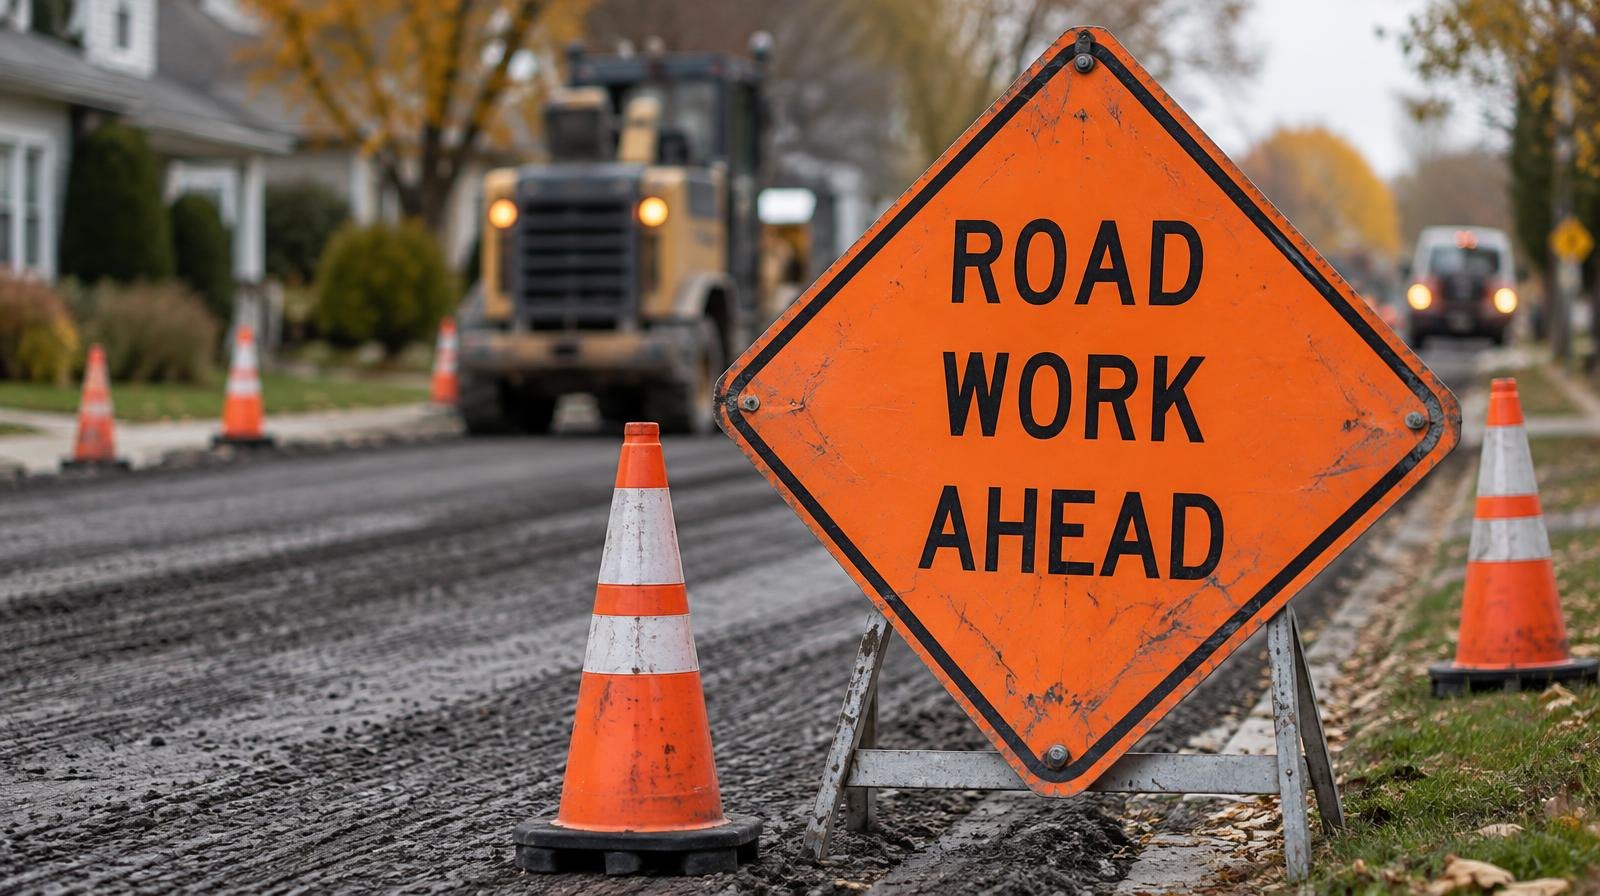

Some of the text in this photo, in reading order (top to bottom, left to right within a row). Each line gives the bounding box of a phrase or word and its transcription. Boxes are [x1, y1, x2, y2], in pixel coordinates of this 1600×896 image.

[951, 218, 1204, 307] ROAD
[942, 351, 1206, 443] WORK
[918, 485, 1225, 581] AHEAD
